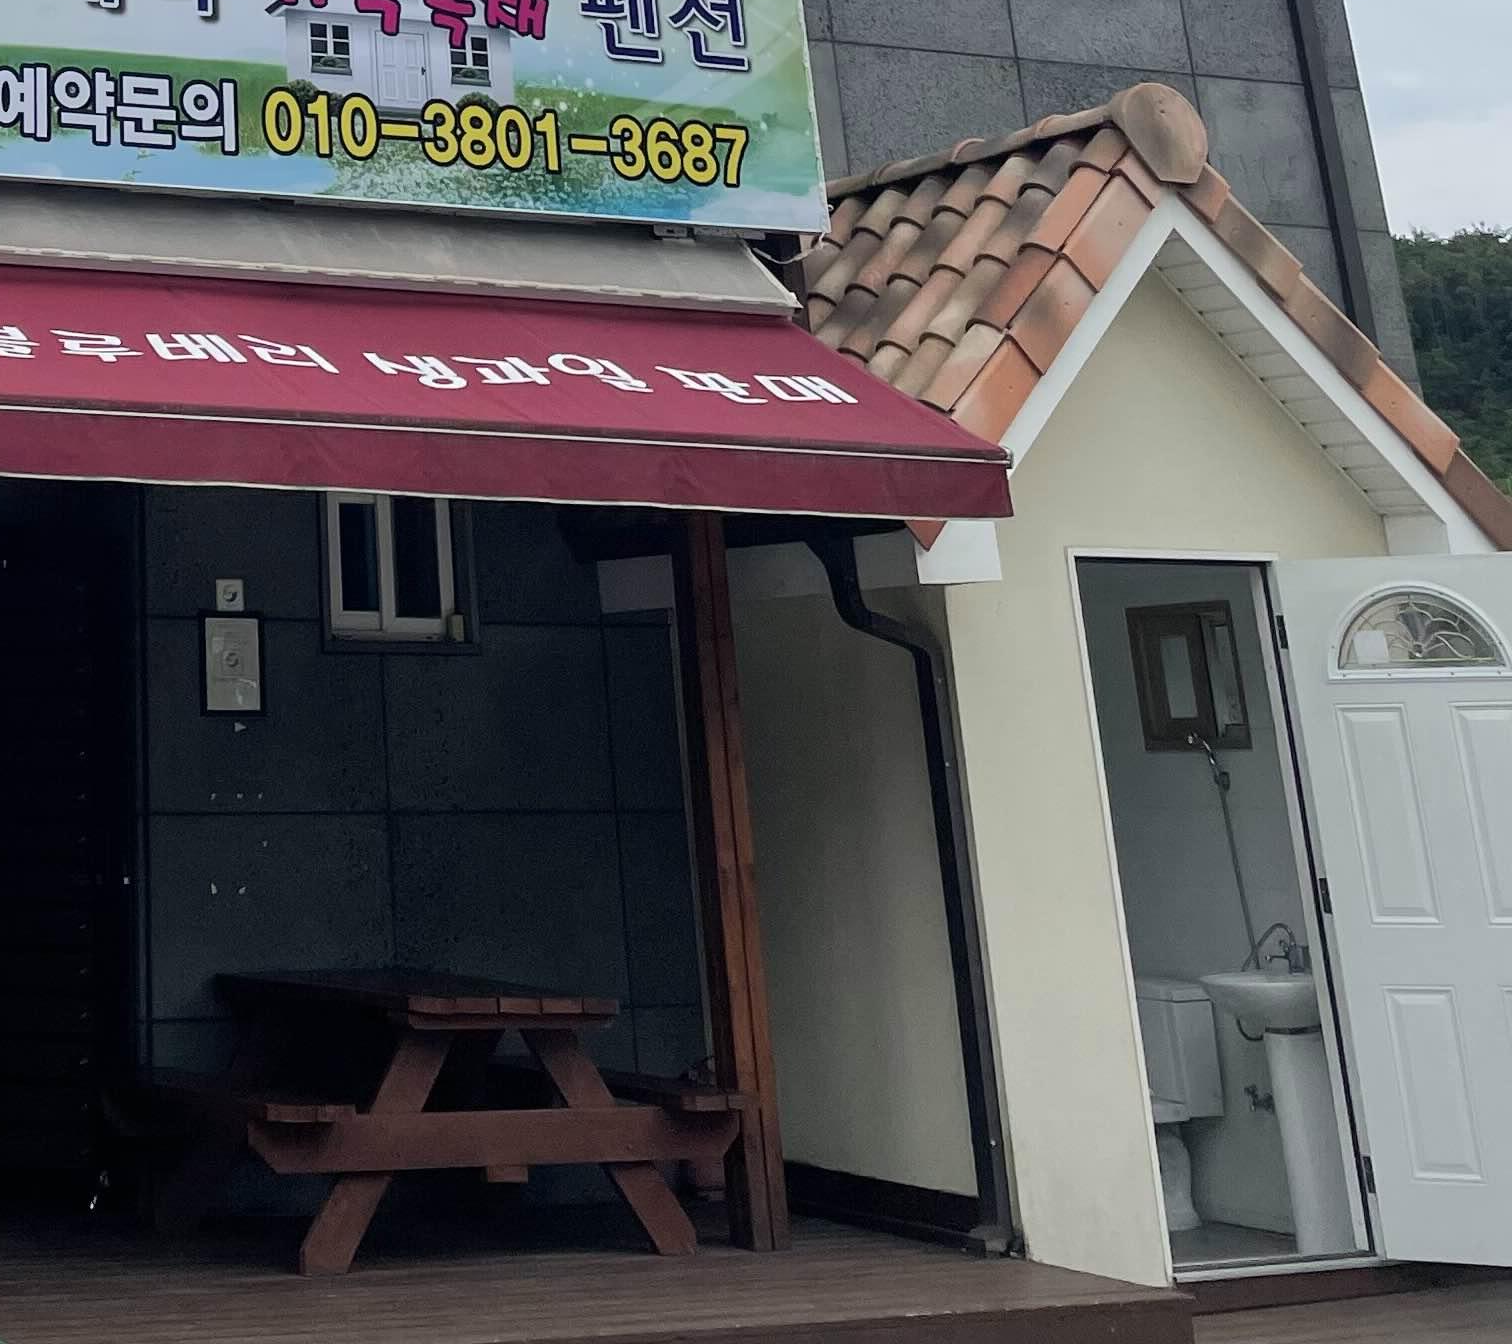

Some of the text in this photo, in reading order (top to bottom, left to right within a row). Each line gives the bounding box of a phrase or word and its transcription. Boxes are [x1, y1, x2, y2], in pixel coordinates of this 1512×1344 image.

[262, 86, 748, 188] 010-3801-3687
[362, 351, 654, 393] 생과일
[655, 365, 858, 404] 판매
